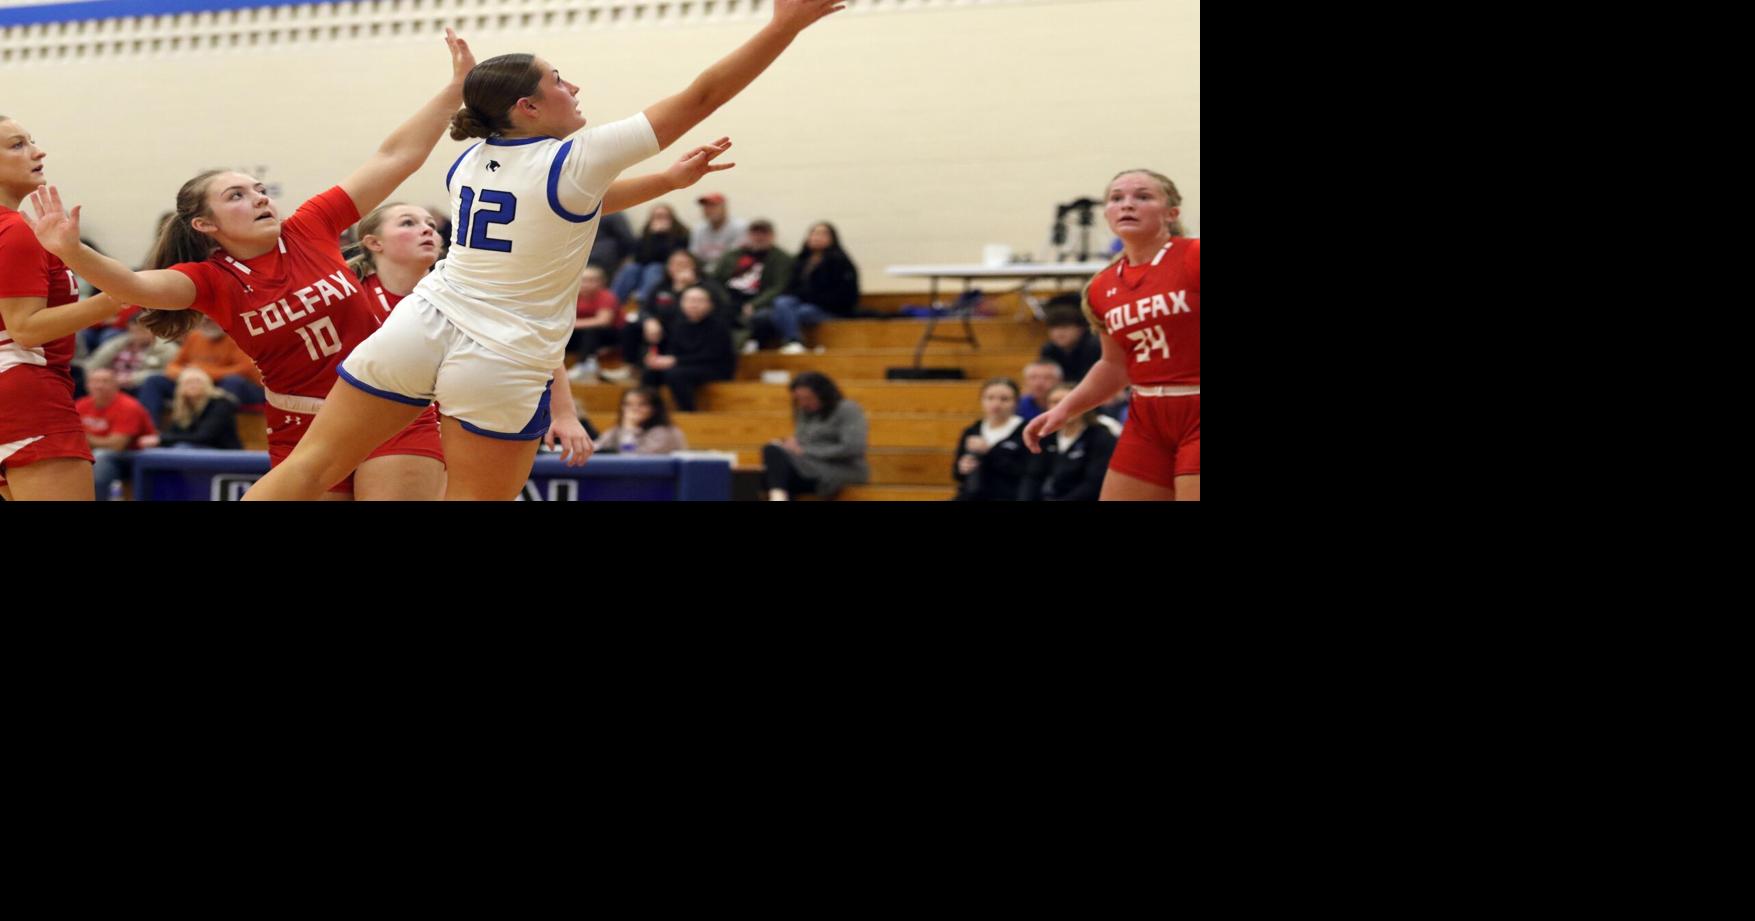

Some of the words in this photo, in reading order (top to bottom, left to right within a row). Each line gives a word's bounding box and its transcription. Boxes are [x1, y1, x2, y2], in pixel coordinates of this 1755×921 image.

[456, 185, 517, 253] 12
[240, 270, 357, 336] COLFAX
[295, 316, 342, 361] 10
[1126, 324, 1169, 363] 34
